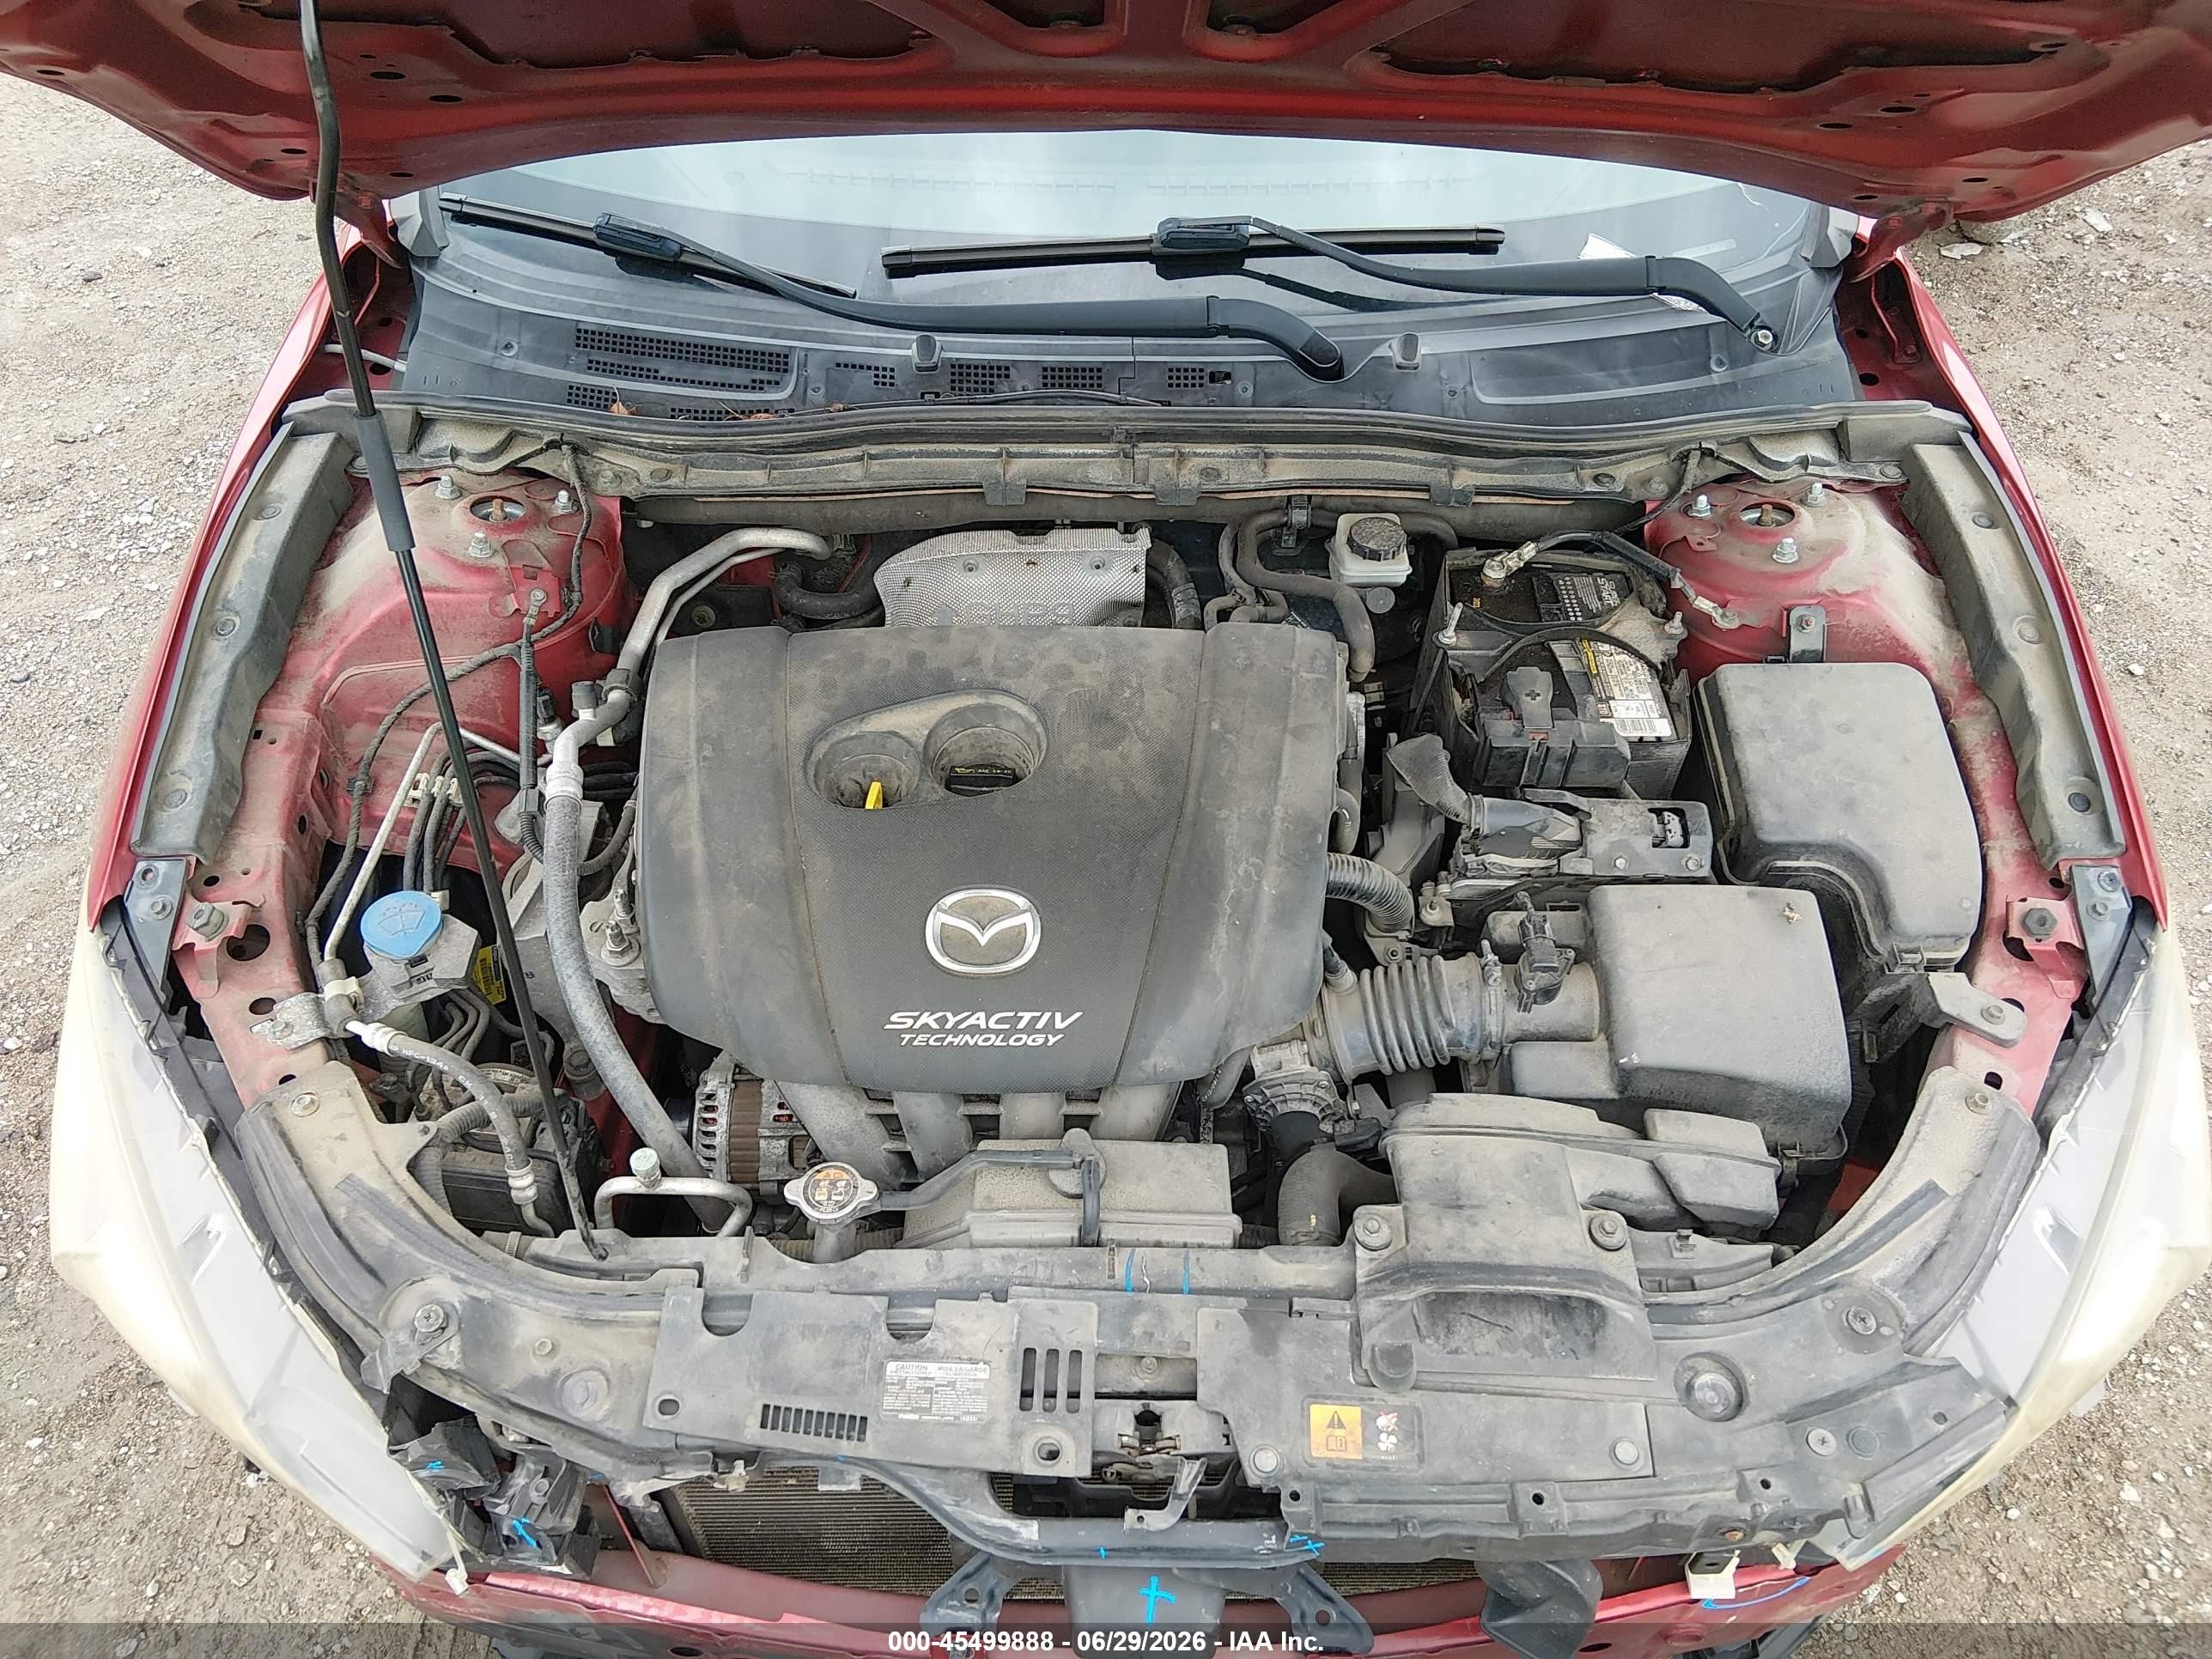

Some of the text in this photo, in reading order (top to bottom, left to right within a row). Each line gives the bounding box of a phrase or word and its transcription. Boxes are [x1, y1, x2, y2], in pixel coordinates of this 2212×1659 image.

[1597, 576, 1614, 607] START
[883, 1011, 1084, 1030] SKYACTIV
[899, 1033, 1065, 1047] TECHNOLOGY
